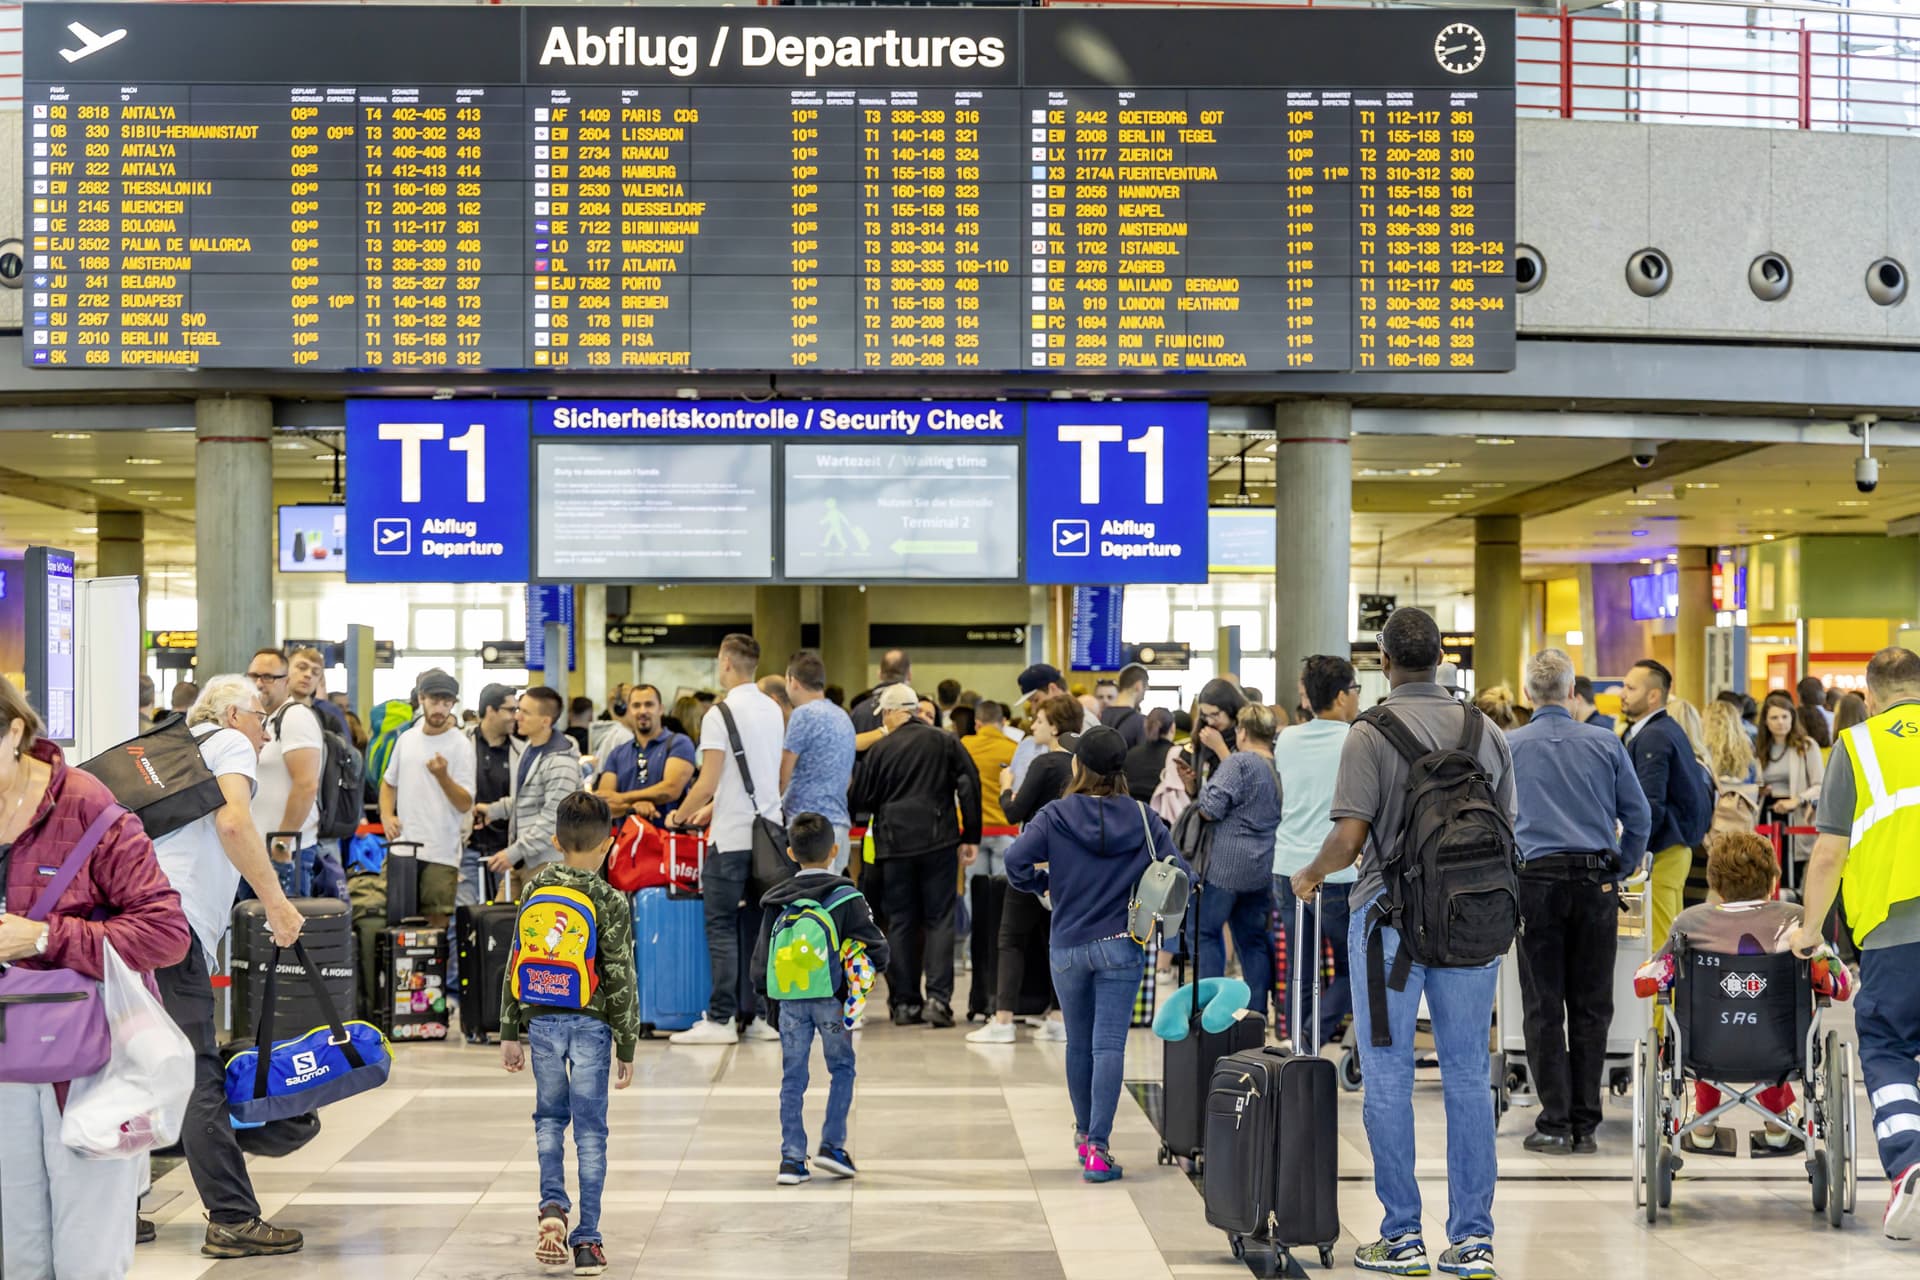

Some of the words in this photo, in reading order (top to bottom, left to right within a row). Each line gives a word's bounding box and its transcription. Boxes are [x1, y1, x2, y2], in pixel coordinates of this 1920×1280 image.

[539, 26, 697, 76] Abflug
[709, 26, 730, 66] /
[743, 27, 1005, 76] Departures
[122, 106, 175, 119] ANTALYA
[456, 108, 480, 121] 413
[622, 109, 661, 122] PARIS
[674, 109, 698, 122] CDG
[891, 110, 945, 123] 336-339
[955, 111, 979, 123] 316
[1119, 111, 1187, 124] GOETEBORG
[1200, 111, 1224, 124] GOT
[1451, 111, 1472, 124] 361
[121, 125, 258, 139] SIBIU-HERMANNSTADT
[457, 127, 481, 140] 343
[622, 128, 683, 141] LISSABON
[892, 129, 945, 142] 140-148
[955, 129, 977, 142] 321
[1119, 130, 1165, 143] BERLIN
[1178, 130, 1216, 143] TEGEL
[1452, 130, 1474, 143] 159
[122, 144, 176, 157] ANTALYA
[457, 146, 481, 159] 416
[622, 146, 669, 160] KRAKAU
[892, 148, 945, 161] 140-148
[955, 148, 979, 161] 324
[1119, 148, 1172, 161] ZUERICH
[1451, 149, 1474, 161] 310
[122, 162, 176, 176] ANTALYA
[457, 164, 480, 177] 414
[622, 165, 676, 179] HAMBURG
[892, 167, 945, 180] 155-158
[956, 167, 979, 180] 163
[1119, 167, 1217, 180] FUERTEVENTURA
[1451, 167, 1474, 180] 360
[122, 181, 211, 195] THESSALONIKI
[457, 183, 481, 196] 325
[622, 184, 684, 197] VALENCIA
[892, 185, 945, 198] 160-169
[955, 185, 979, 198] 323
[1119, 185, 1180, 199] HANNOVER
[1451, 186, 1472, 198] 161
[121, 200, 183, 214] MUENCHEN
[458, 202, 480, 215] 162
[622, 202, 705, 216] DUESSELDORF
[892, 203, 945, 217] 155-158
[956, 204, 979, 217] 156
[1119, 204, 1164, 217] NEAPEL
[1450, 204, 1474, 217] 322
[121, 219, 176, 233] BOLOGNA
[457, 221, 479, 234] 361
[622, 221, 699, 234] BIRMINGHAM
[891, 222, 945, 235] 313-314
[955, 222, 979, 235] 413
[1119, 223, 1187, 236] AMSTERDAM
[1450, 223, 1474, 236] 316
[122, 238, 161, 251] PALMA
[166, 238, 182, 251] DE
[190, 238, 251, 252] MALLORCA
[457, 239, 481, 252] 408
[622, 240, 684, 253] WARSCHAU
[891, 241, 944, 254] 303-304
[955, 241, 979, 254] 314
[1121, 241, 1179, 255] ISTANBUL
[1451, 241, 1504, 254] 123-124
[122, 256, 191, 270] AMSTERDAM
[457, 258, 481, 271] 310
[622, 258, 676, 272] ATLANTA
[891, 259, 945, 273] 330-335
[956, 260, 1008, 273] 109-110
[1118, 260, 1165, 273] ZAGREB
[1451, 260, 1504, 273] 121-122
[121, 275, 176, 289] BELGRAD
[457, 277, 480, 290] 337
[622, 276, 661, 290] PORTO
[955, 278, 979, 291] 408
[1118, 278, 1172, 292] MAILAND
[1185, 278, 1239, 292] BERGAMO
[1450, 279, 1474, 292] 405
[121, 294, 183, 308] BUDAPEST
[458, 296, 480, 309] 173
[622, 295, 669, 309] BREMEN
[956, 297, 979, 310] 158
[1119, 297, 1165, 311] LONDON
[1177, 297, 1239, 311] HEATHROW
[1450, 297, 1504, 310] 343-344
[121, 312, 168, 326] MOSKAU
[181, 313, 206, 326] SVO
[457, 314, 480, 327] 342
[622, 314, 654, 328] WIEN
[956, 316, 979, 329] 164
[1119, 316, 1165, 329] ANKARA
[1450, 316, 1474, 328] 414
[121, 331, 168, 345] BERLIN
[182, 331, 220, 345] TEGEL
[458, 333, 480, 345] 117
[622, 333, 653, 346] PISA
[955, 334, 979, 347] 325
[1118, 334, 1143, 348] ROM
[1155, 334, 1224, 348] FIUMICINO
[1450, 334, 1474, 348] 323
[122, 350, 199, 364] KOPENHAGEN
[457, 352, 480, 365] 312
[622, 352, 690, 365] FRANKFURT
[957, 353, 978, 365] 144
[1118, 353, 1157, 366] PALMA
[1163, 353, 1178, 367] DE
[1186, 353, 1246, 367] MALLORCA
[1450, 353, 1474, 366] 324
[554, 407, 799, 430] Sicherheitskontrolle
[805, 408, 814, 430] /
[820, 408, 921, 434] Security
[927, 408, 1004, 430] Check
[379, 424, 486, 503] T1
[816, 454, 881, 468] Wartezeit
[902, 454, 955, 470] Waiting
[956, 454, 988, 468] time
[1058, 425, 1164, 504] T1
[422, 518, 477, 538] Abflug
[902, 516, 960, 529] Terminal
[961, 516, 971, 529] 2
[1101, 519, 1156, 539] Abflug
[422, 540, 504, 559] Departure
[1101, 541, 1182, 560] Departure
